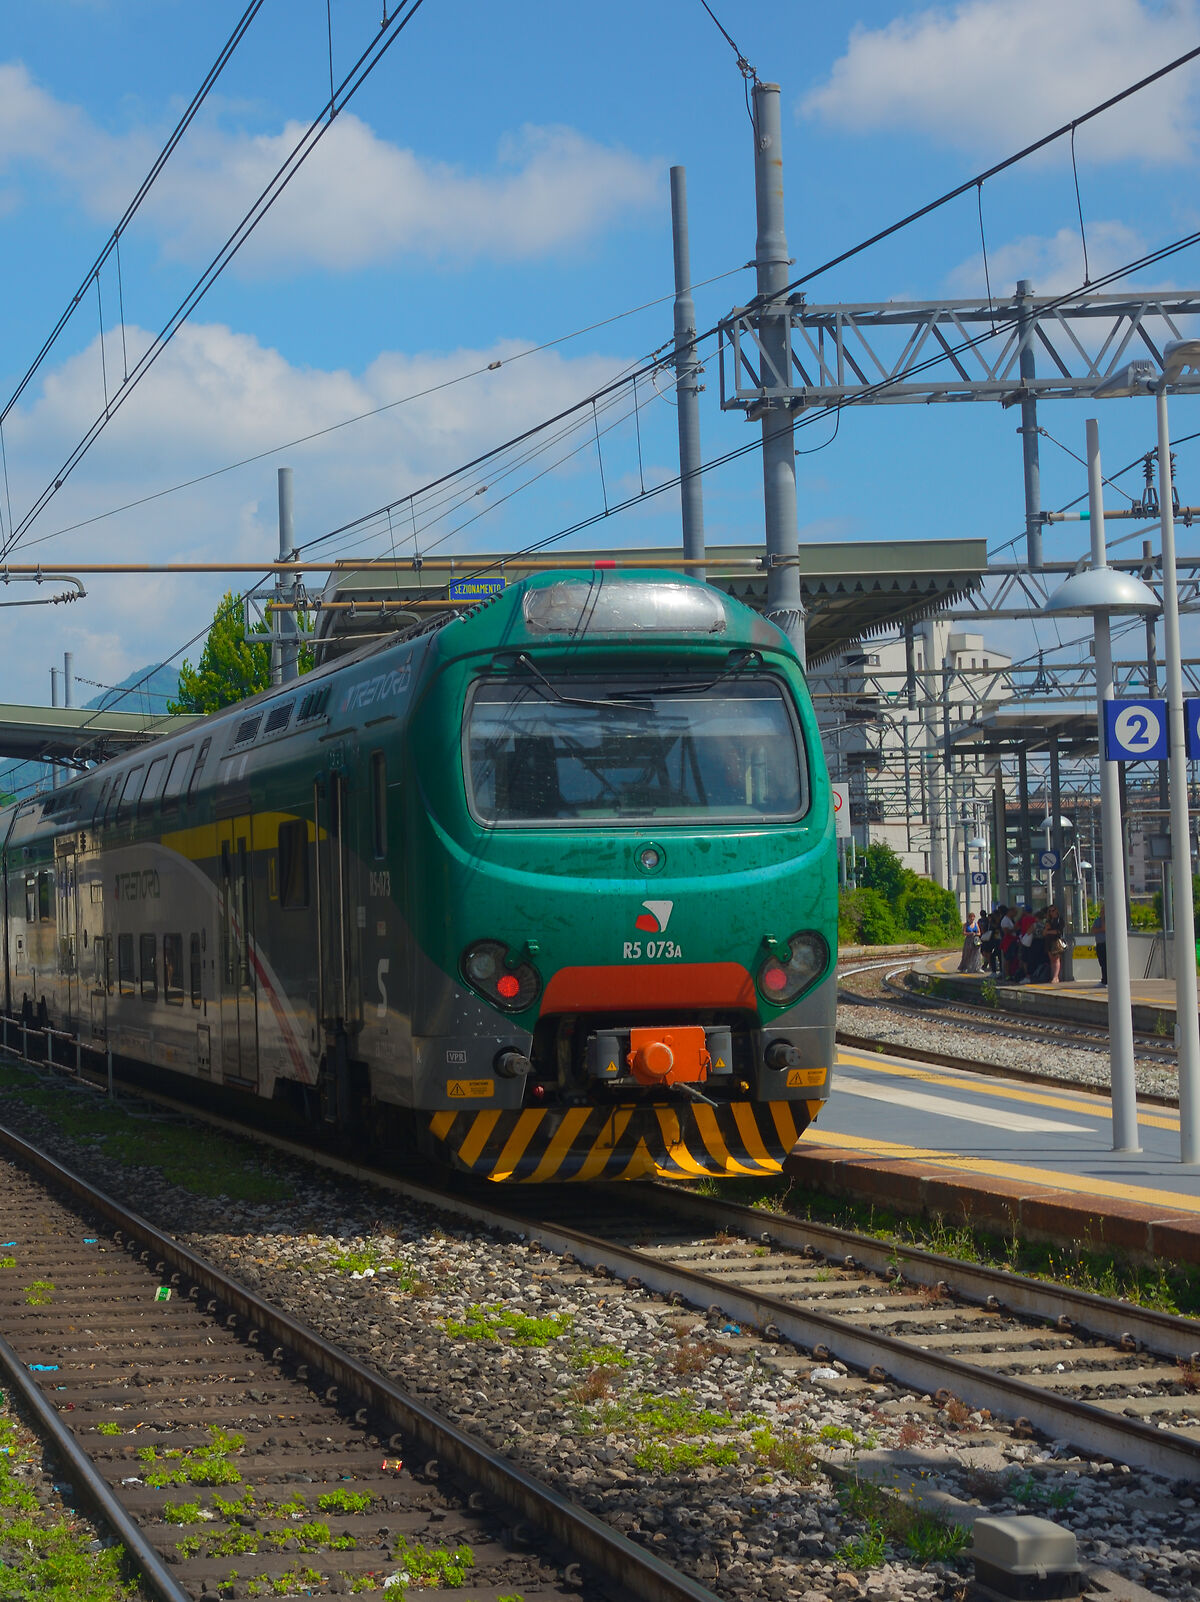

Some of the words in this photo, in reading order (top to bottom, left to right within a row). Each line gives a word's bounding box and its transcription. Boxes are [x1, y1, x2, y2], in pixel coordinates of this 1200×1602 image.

[455, 583, 501, 594] SEZIONAMENTO
[1126, 714, 1150, 744] 2
[624, 942, 642, 959] R5
[448, 1052, 464, 1062] VPR
